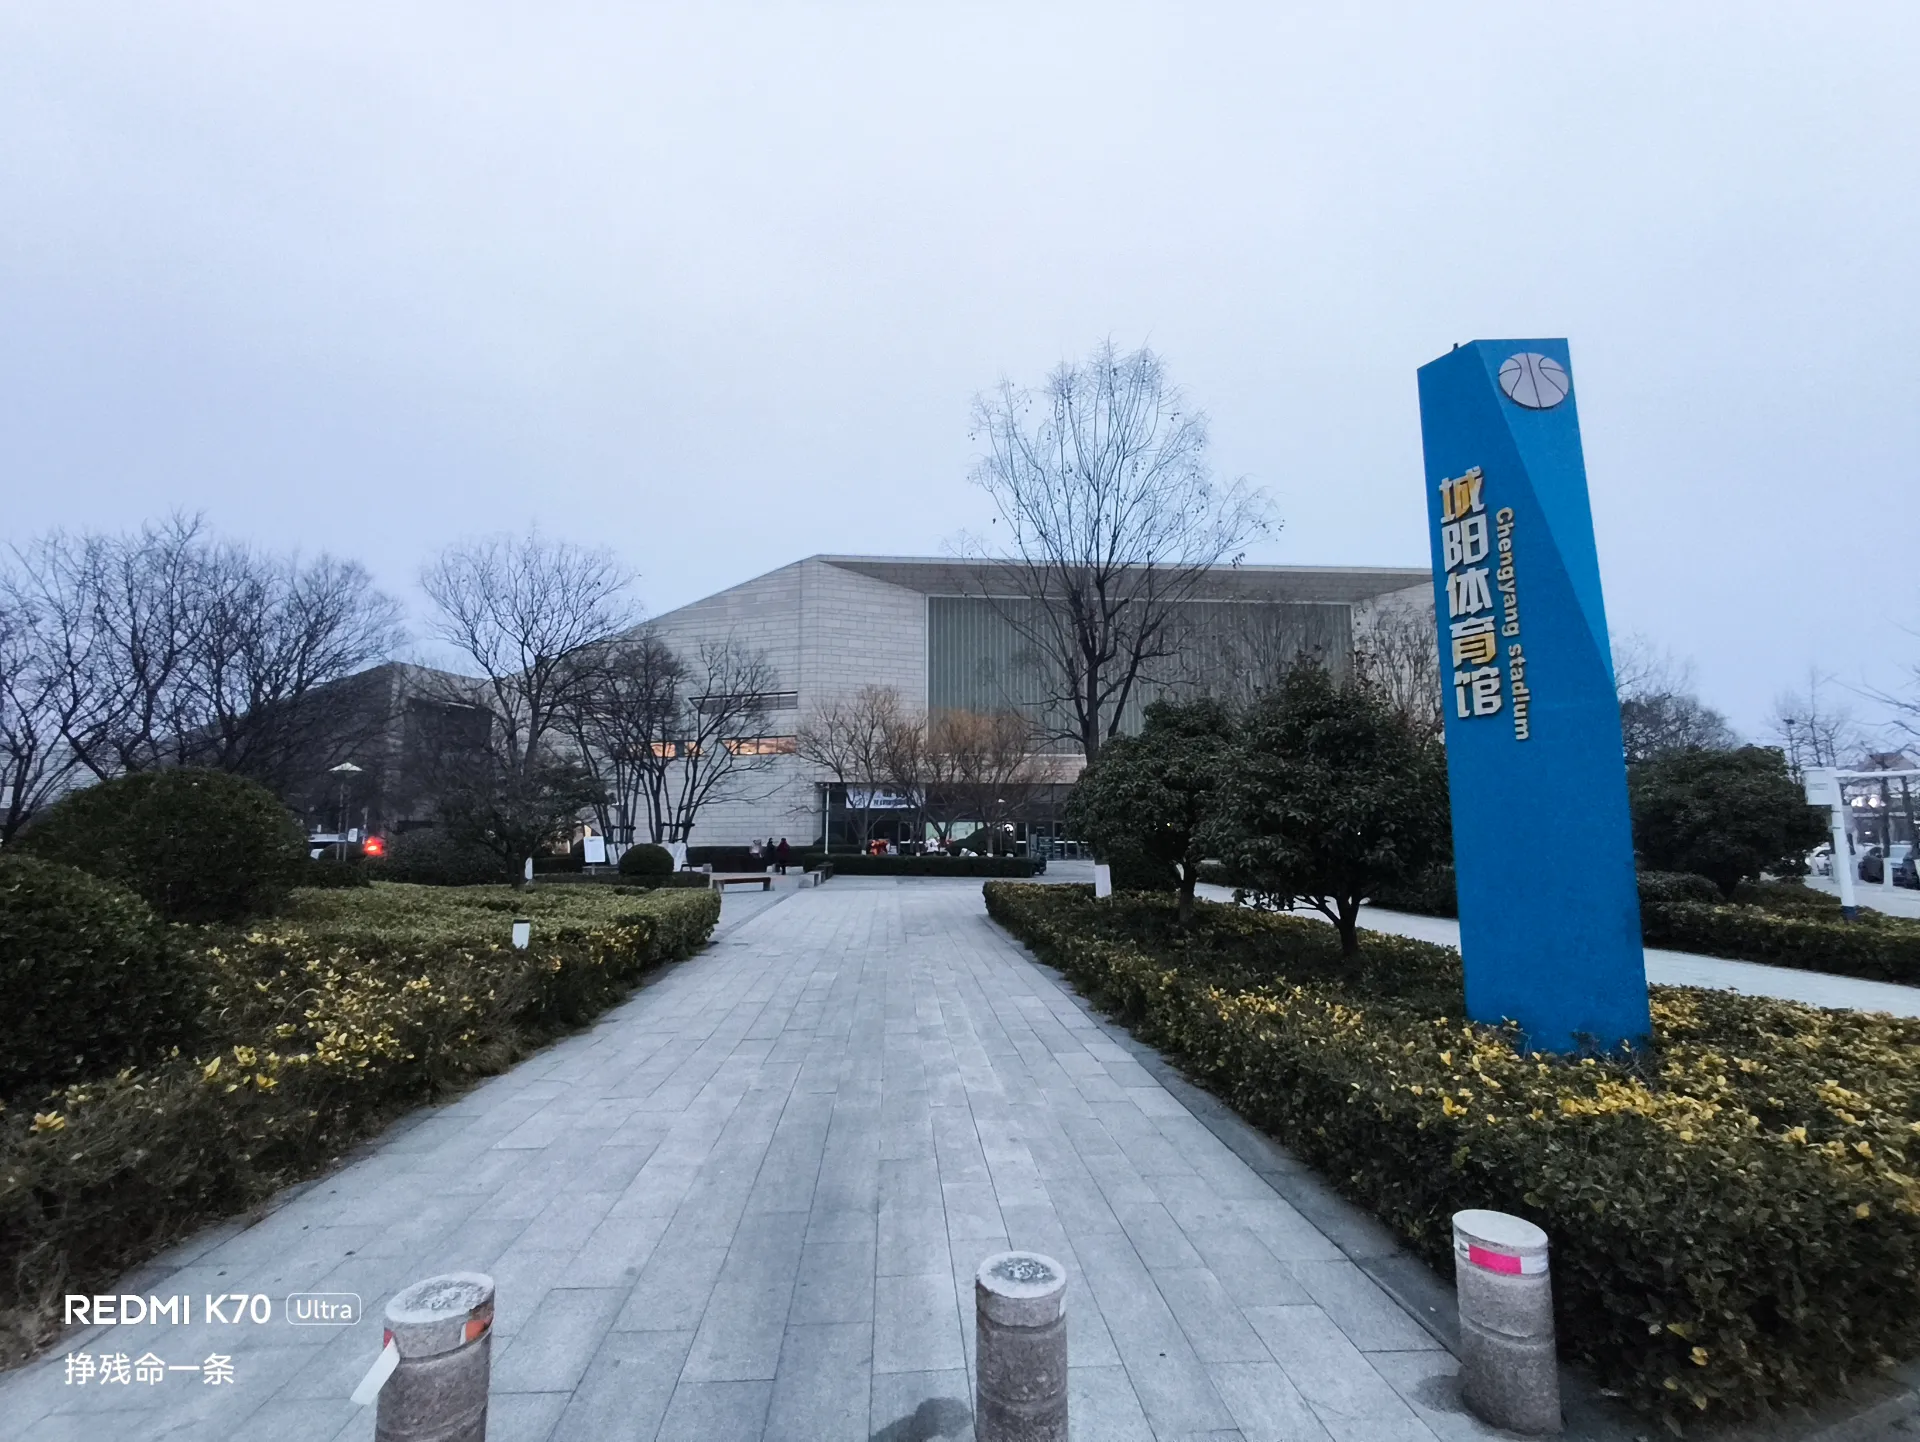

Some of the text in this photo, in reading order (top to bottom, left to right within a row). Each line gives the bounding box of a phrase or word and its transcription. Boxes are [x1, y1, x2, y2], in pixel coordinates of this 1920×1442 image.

[1438, 465, 1502, 718] 城阳体育馆
[1496, 506, 1530, 741] Chengyang stadium
